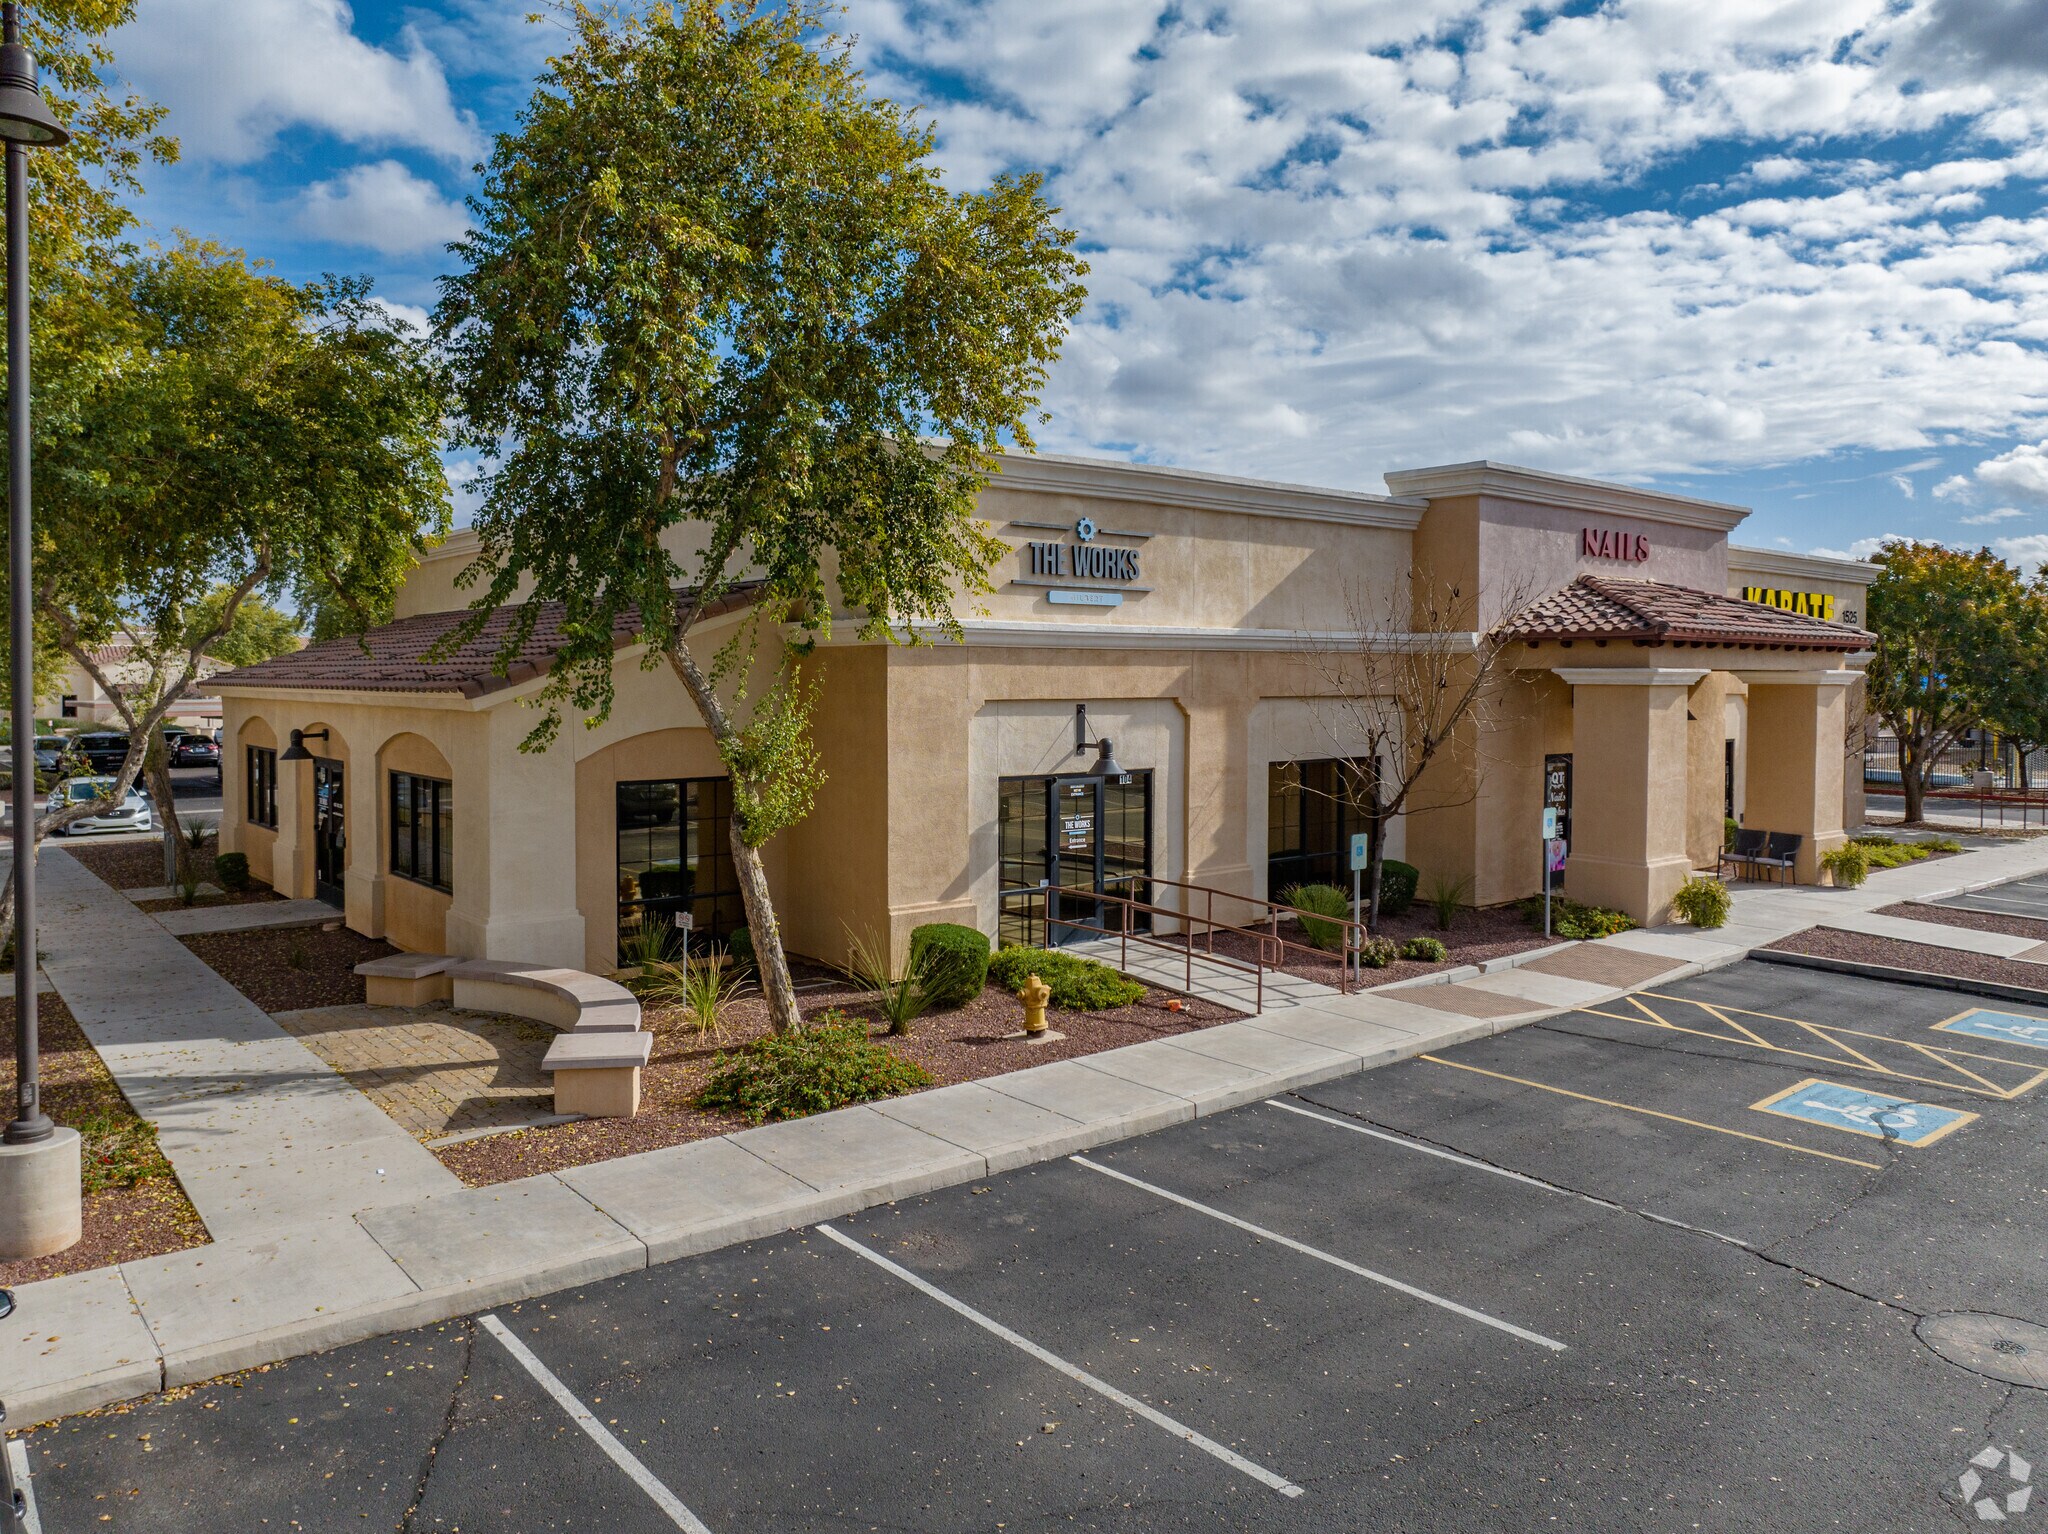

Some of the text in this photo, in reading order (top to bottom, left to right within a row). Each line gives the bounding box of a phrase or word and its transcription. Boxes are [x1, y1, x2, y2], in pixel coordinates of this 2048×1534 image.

[1583, 527, 1650, 562] NAILS
[1029, 542, 1140, 580] THE WORKS
[1842, 610, 1858, 624] 1525
[1120, 774, 1132, 784] 104
[1551, 772, 1565, 784] QT
[1065, 820, 1090, 829] THE WORKS
